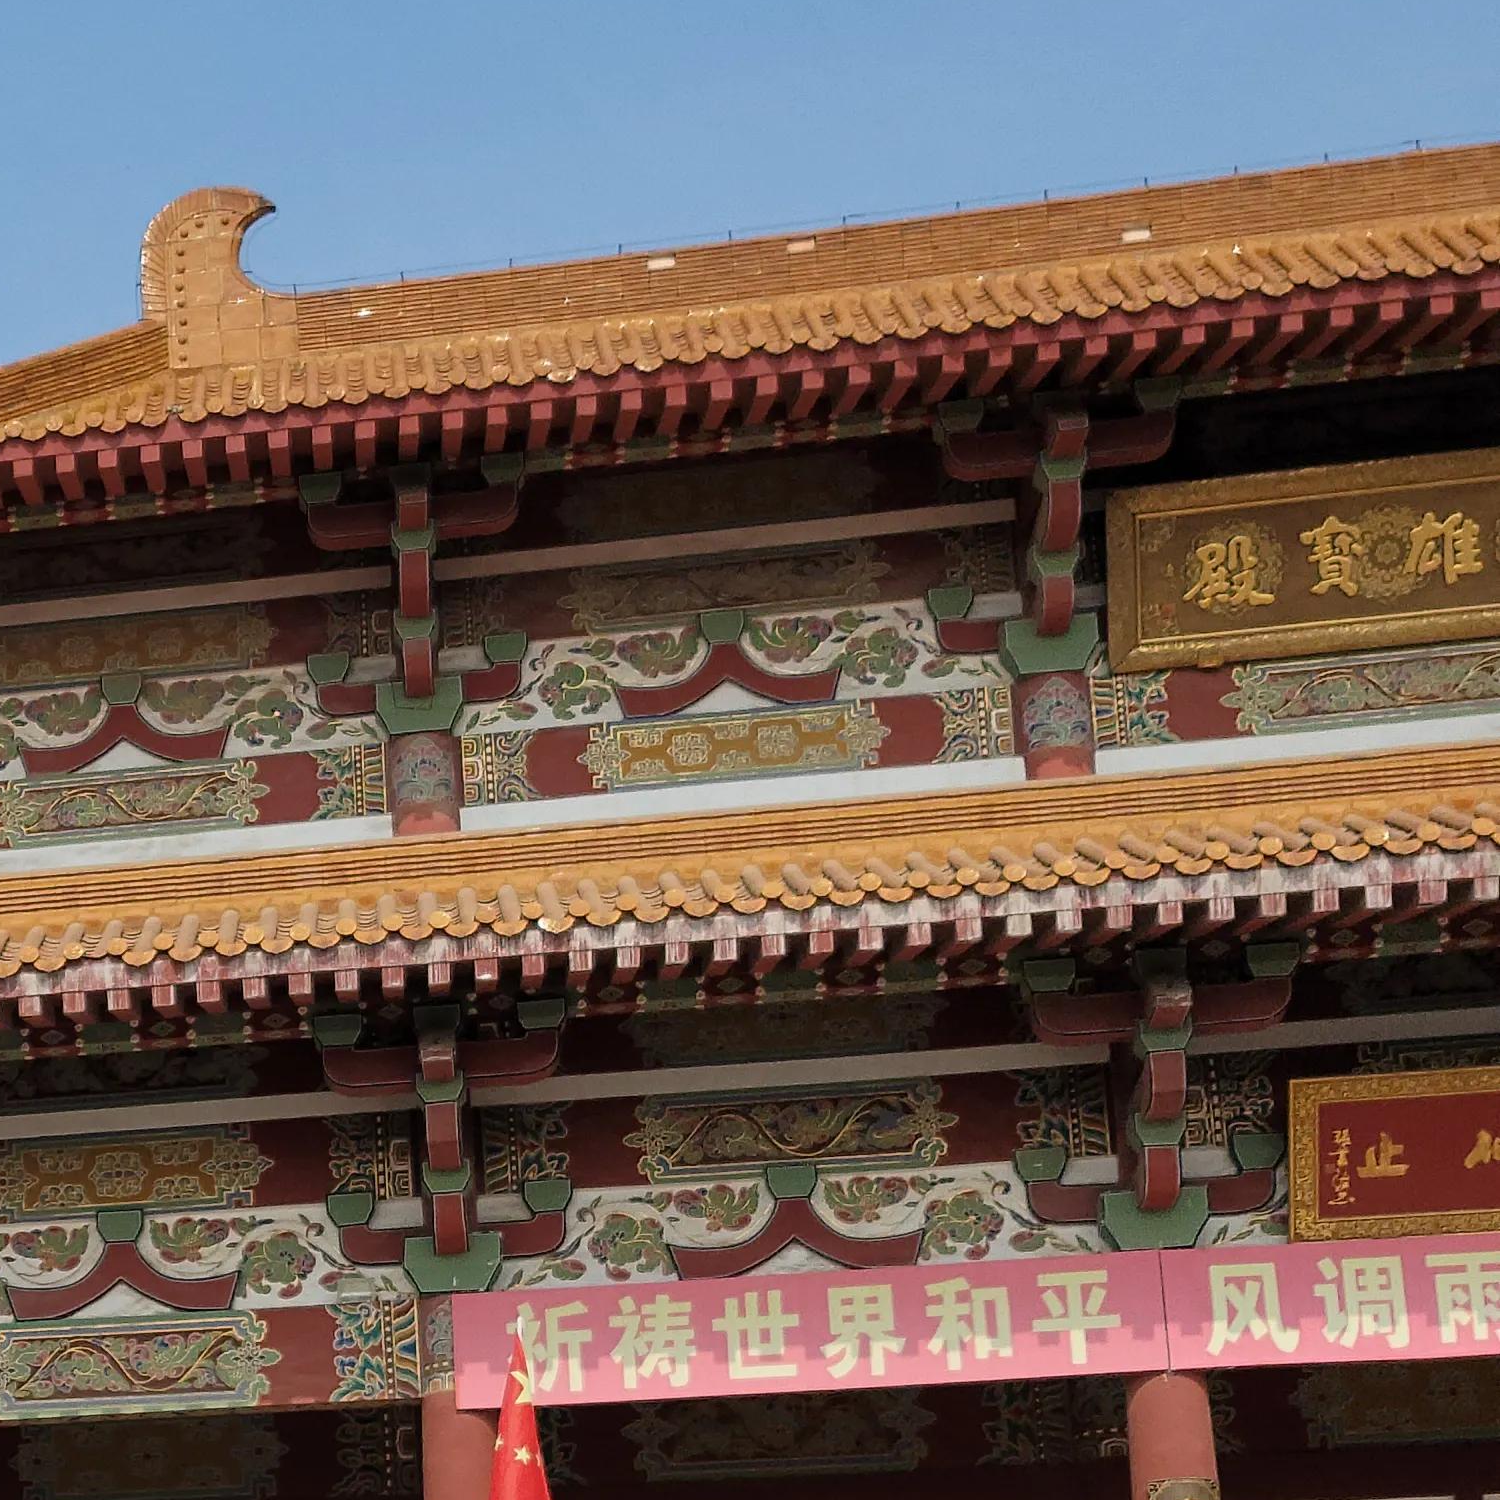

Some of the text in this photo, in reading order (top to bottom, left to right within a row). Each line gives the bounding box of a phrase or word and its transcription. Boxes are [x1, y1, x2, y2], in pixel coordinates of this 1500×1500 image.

[506, 1269, 1122, 1393] 祈祷世界和平
